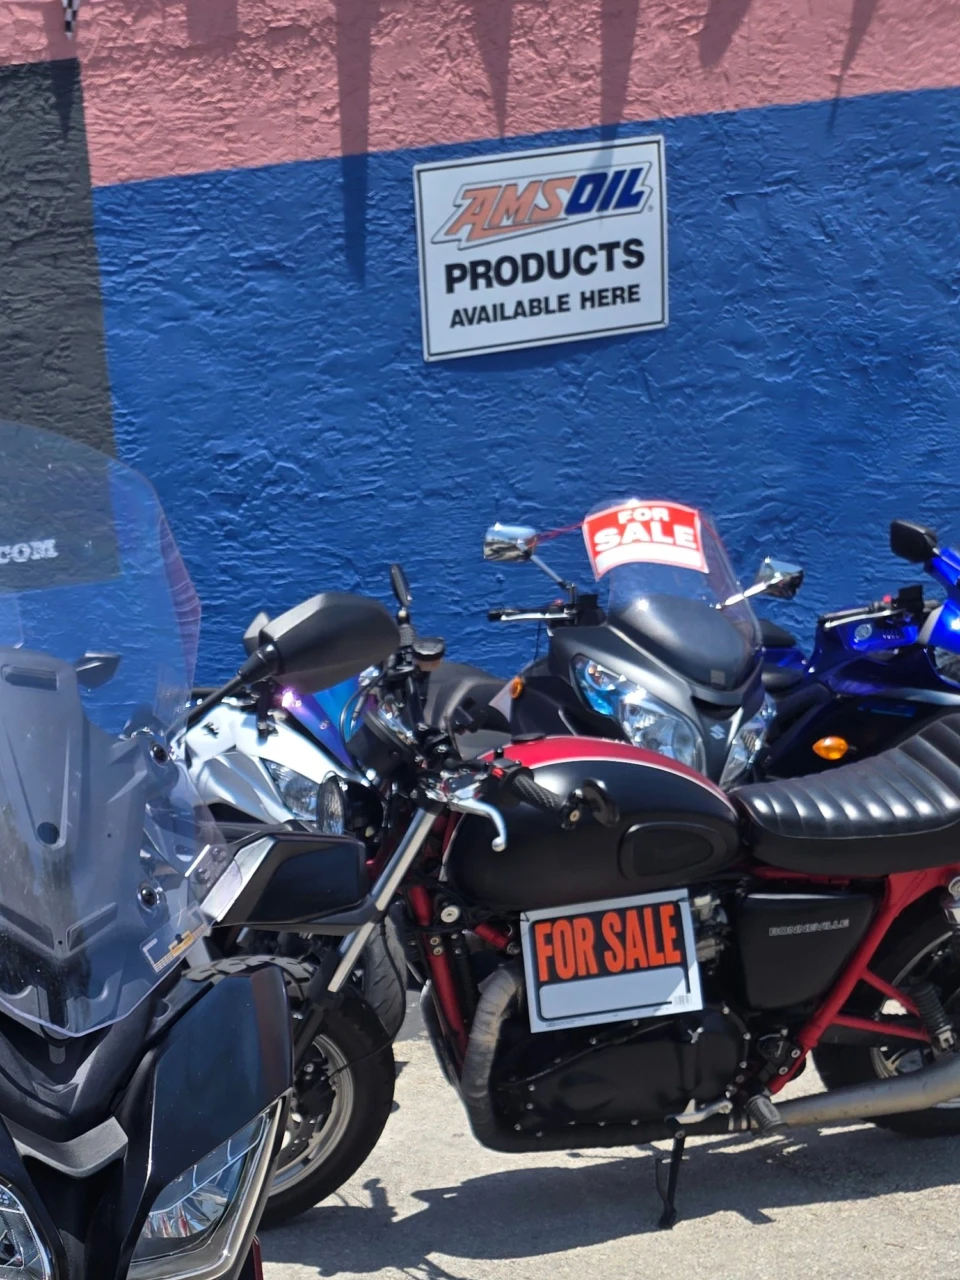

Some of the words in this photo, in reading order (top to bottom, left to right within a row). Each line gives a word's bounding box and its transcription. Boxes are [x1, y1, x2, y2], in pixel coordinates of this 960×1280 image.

[442, 167, 646, 243] AMSOIL
[444, 238, 646, 294] PRODUCTS
[449, 293, 571, 328] AVAILABLE
[579, 284, 641, 310] HERE
[593, 521, 698, 552] SALE
[617, 507, 670, 525] FOR
[534, 917, 599, 982] FOR
[601, 903, 682, 973] SALE
